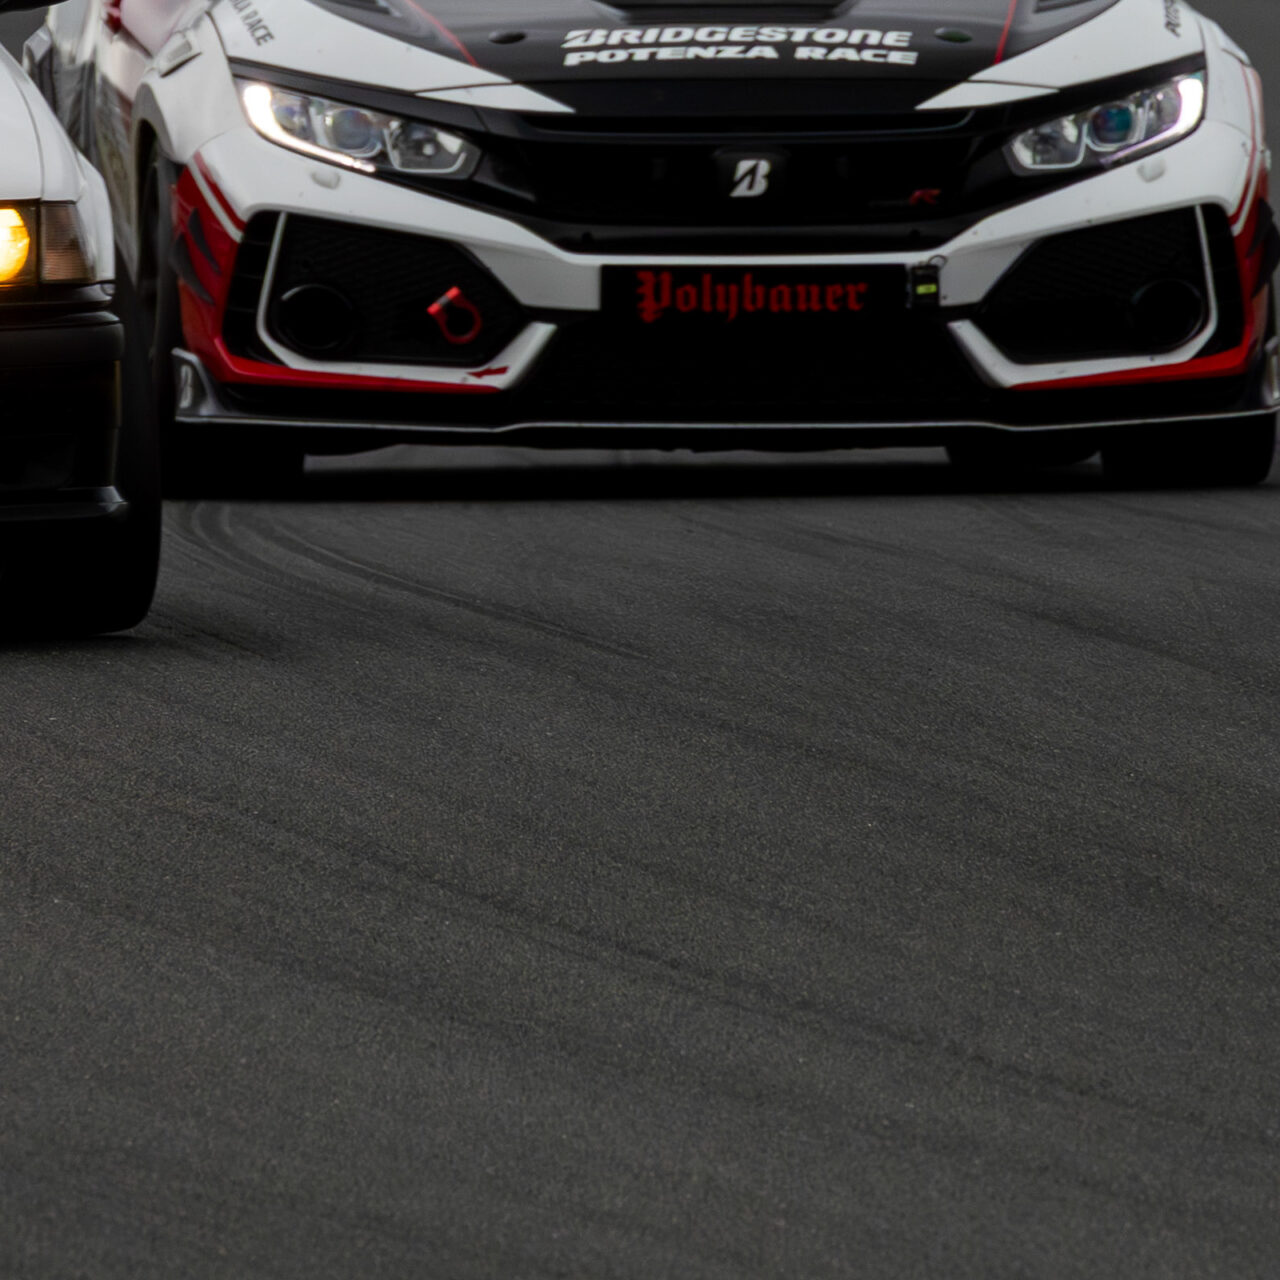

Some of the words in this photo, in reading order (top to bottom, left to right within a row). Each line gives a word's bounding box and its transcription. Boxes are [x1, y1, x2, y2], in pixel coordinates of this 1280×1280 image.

[561, 26, 913, 48] BRIDGESTONE
[564, 46, 779, 67] POTENZA
[794, 46, 918, 65] RACE
[636, 270, 868, 323] Polybauer
